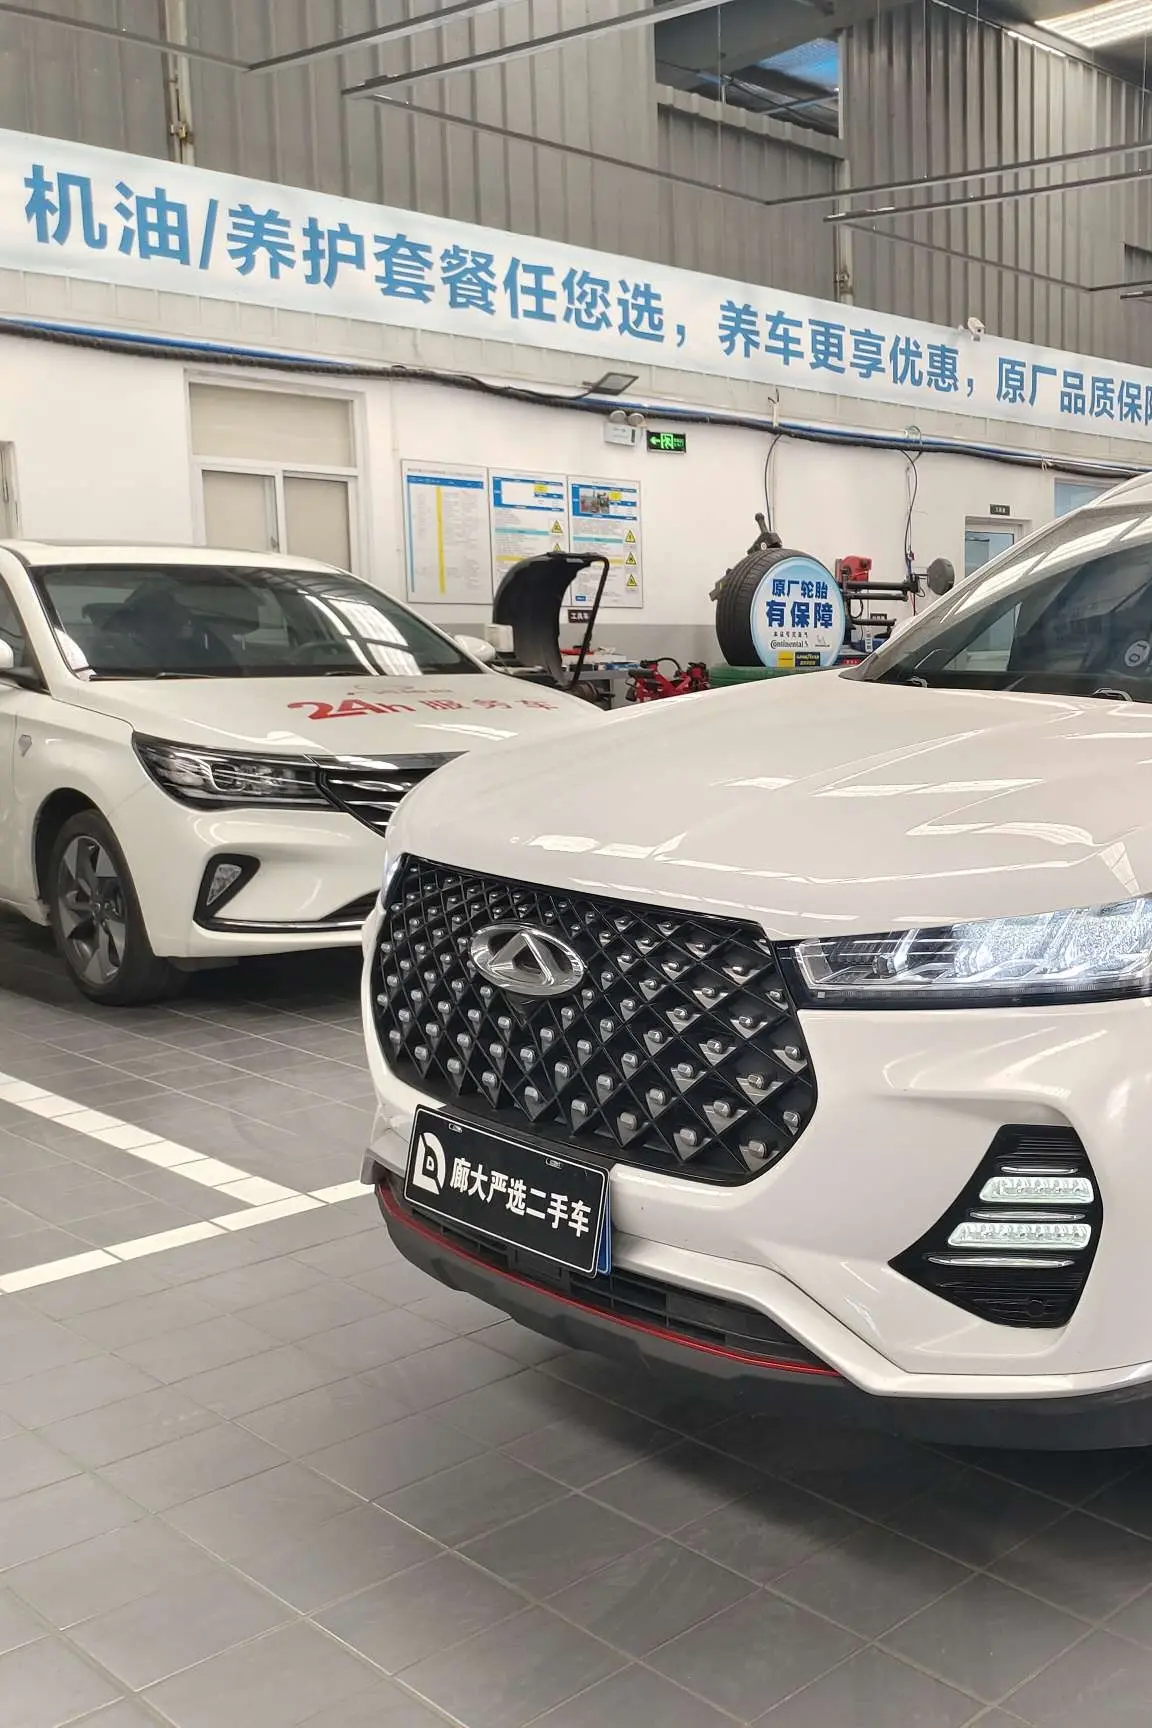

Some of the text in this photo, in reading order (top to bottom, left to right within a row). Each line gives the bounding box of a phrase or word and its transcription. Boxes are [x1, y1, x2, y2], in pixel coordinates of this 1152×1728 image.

[772, 579, 828, 599] 原厂轮胎
[766, 600, 833, 628] 有保障
[449, 1157, 593, 1238] 廊大严选二手车
